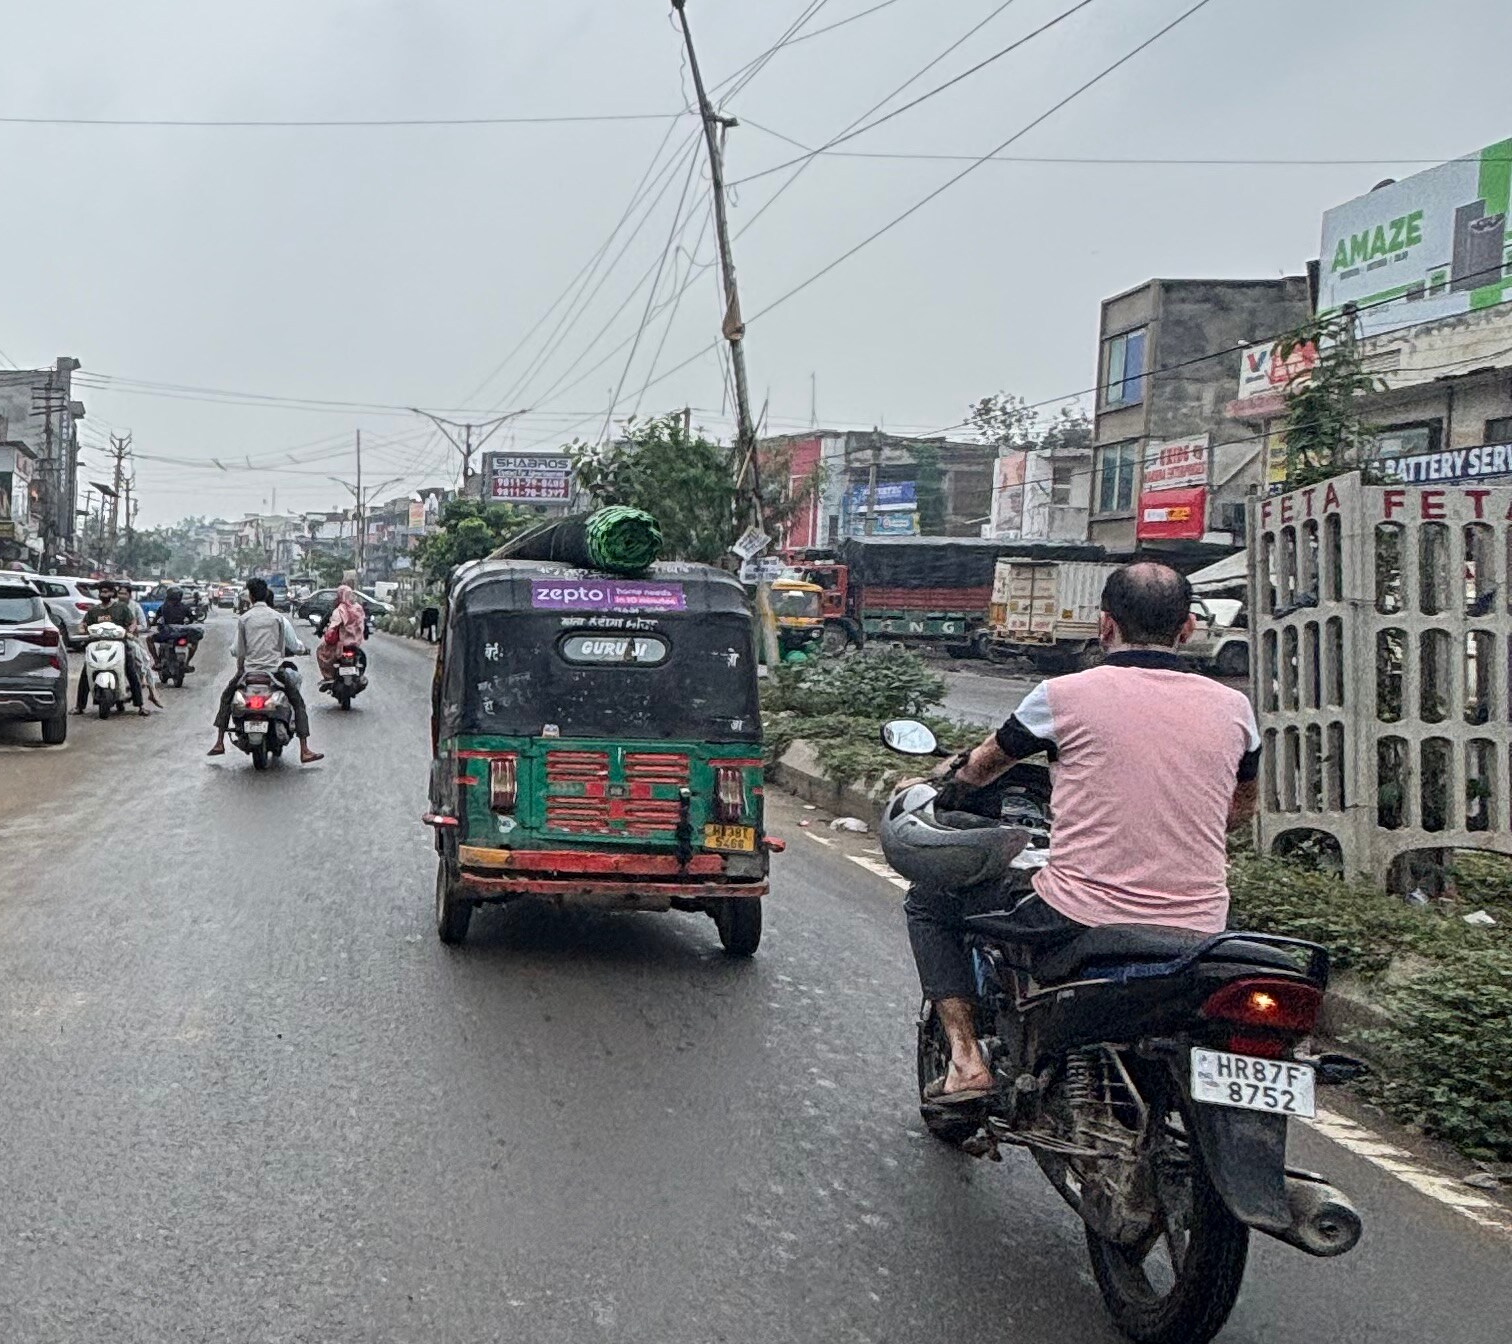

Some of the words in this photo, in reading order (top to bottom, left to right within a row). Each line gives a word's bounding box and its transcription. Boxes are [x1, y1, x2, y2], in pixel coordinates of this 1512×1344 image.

[1331, 209, 1424, 274] AMAZE
[496, 458, 569, 469] SHABROS
[1384, 450, 1467, 483] BATTERY
[1261, 482, 1341, 529] FETA
[537, 587, 604, 604] zepto
[1216, 1054, 1302, 1089] HR87F
[1228, 1081, 1297, 1112] 8752
